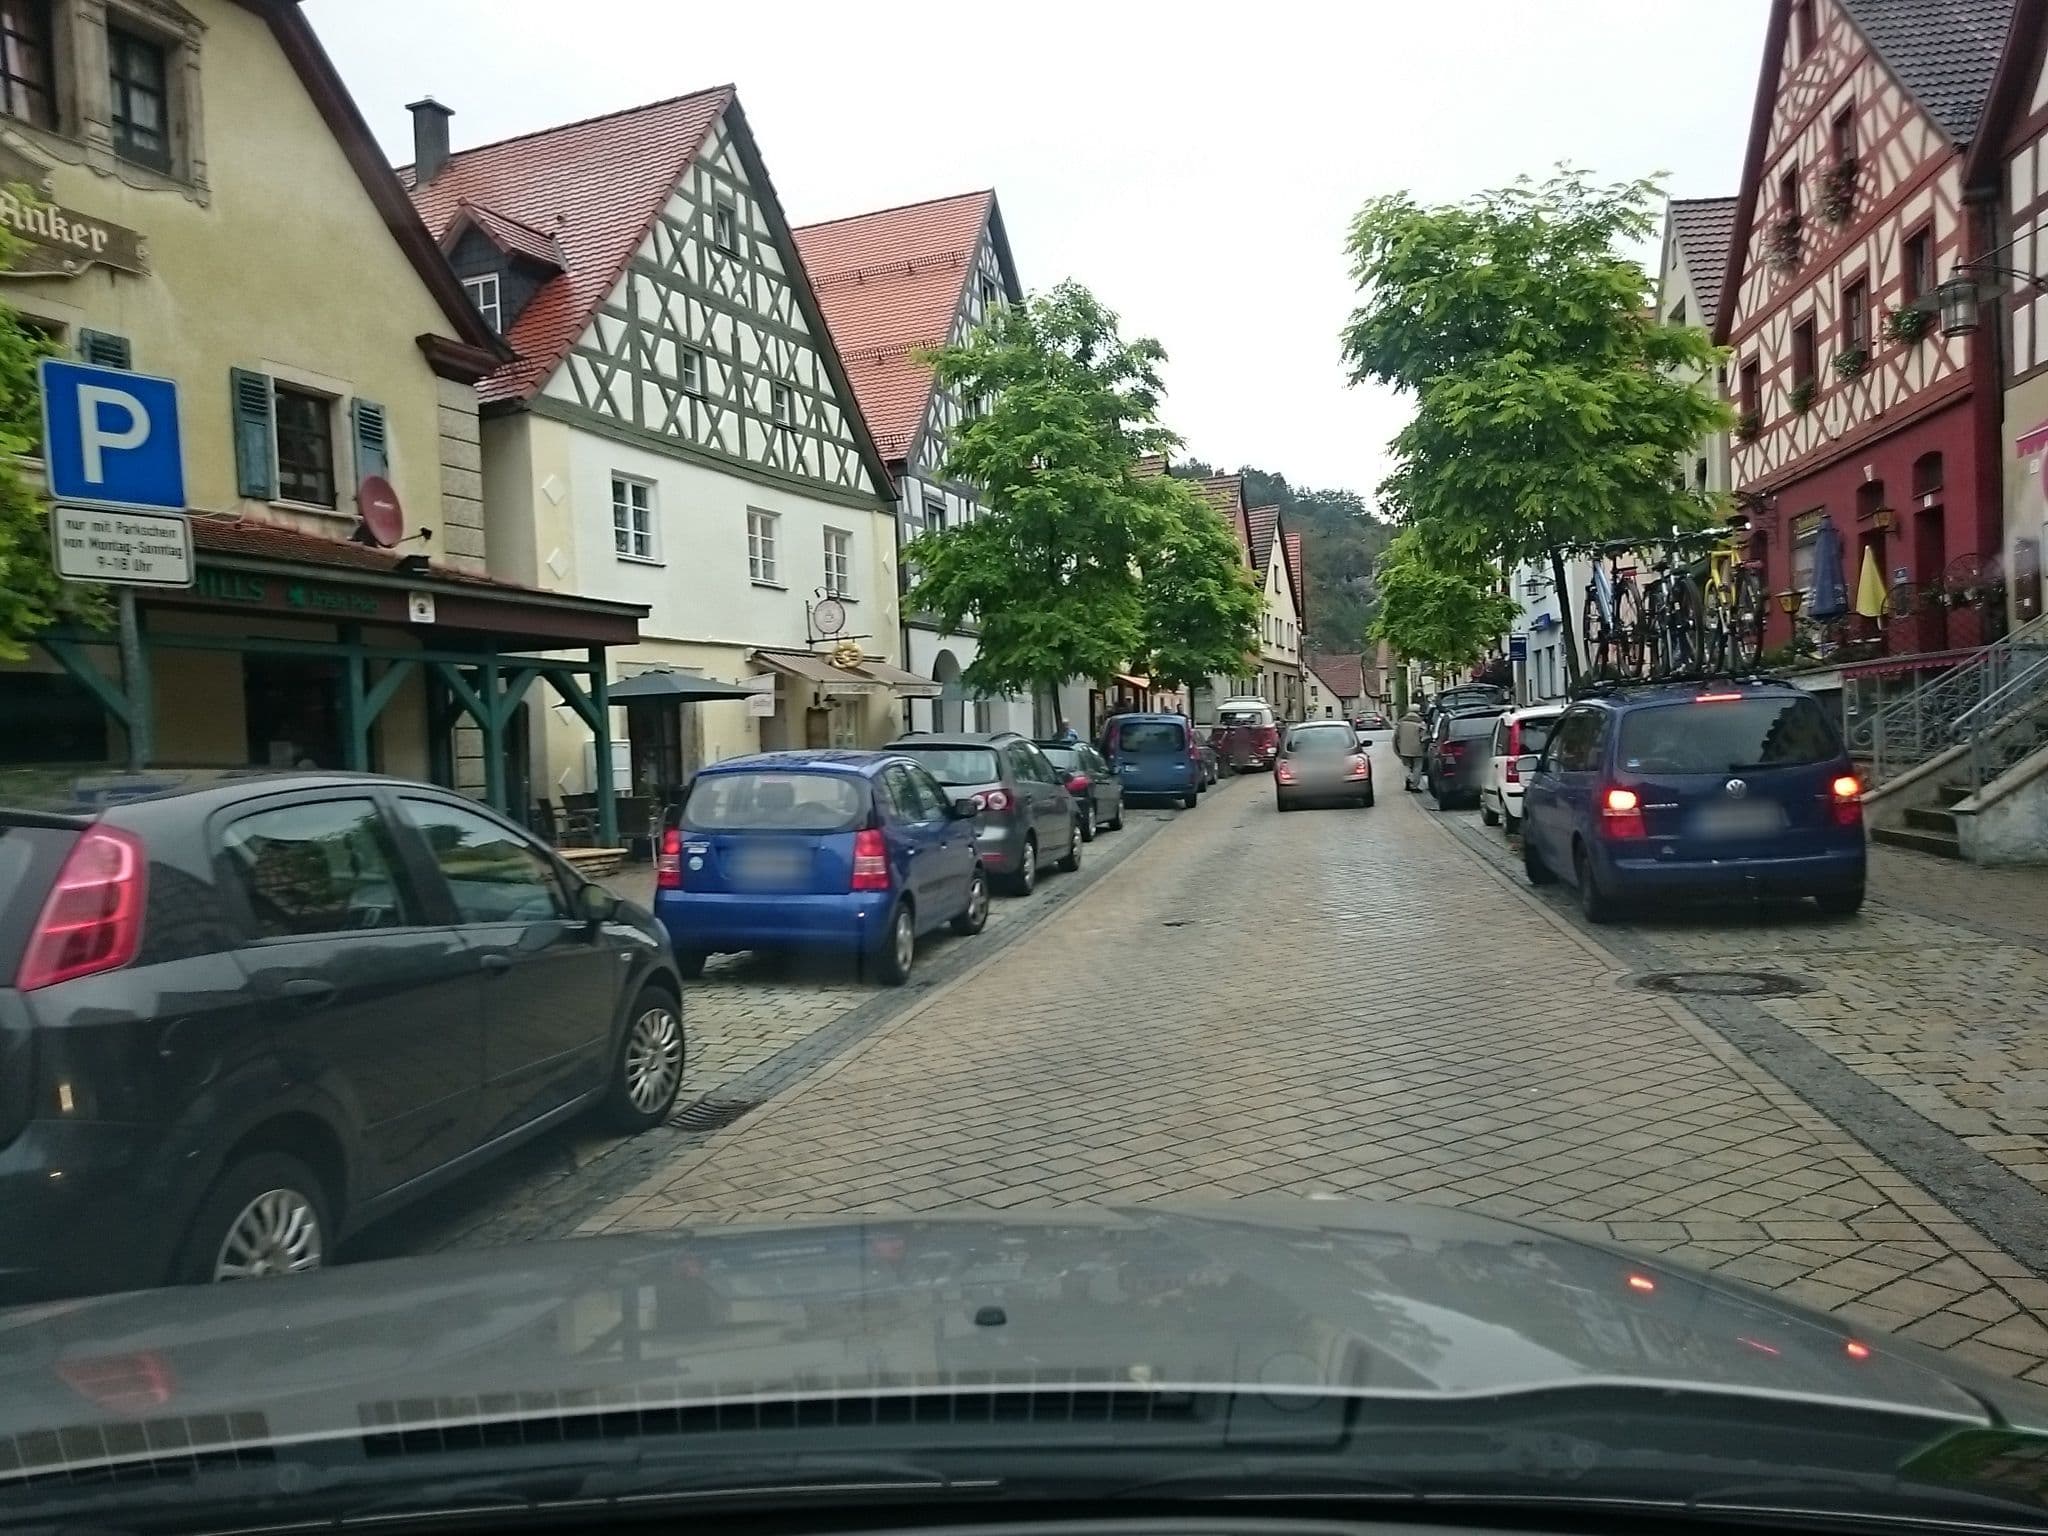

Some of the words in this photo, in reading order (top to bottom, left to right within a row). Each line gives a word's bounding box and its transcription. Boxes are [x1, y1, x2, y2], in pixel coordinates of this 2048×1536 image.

[77, 383, 151, 484] P
[65, 519, 86, 531] nur
[93, 520, 112, 533] mit
[116, 521, 177, 538] Parkschein
[134, 559, 153, 572] Uhr
